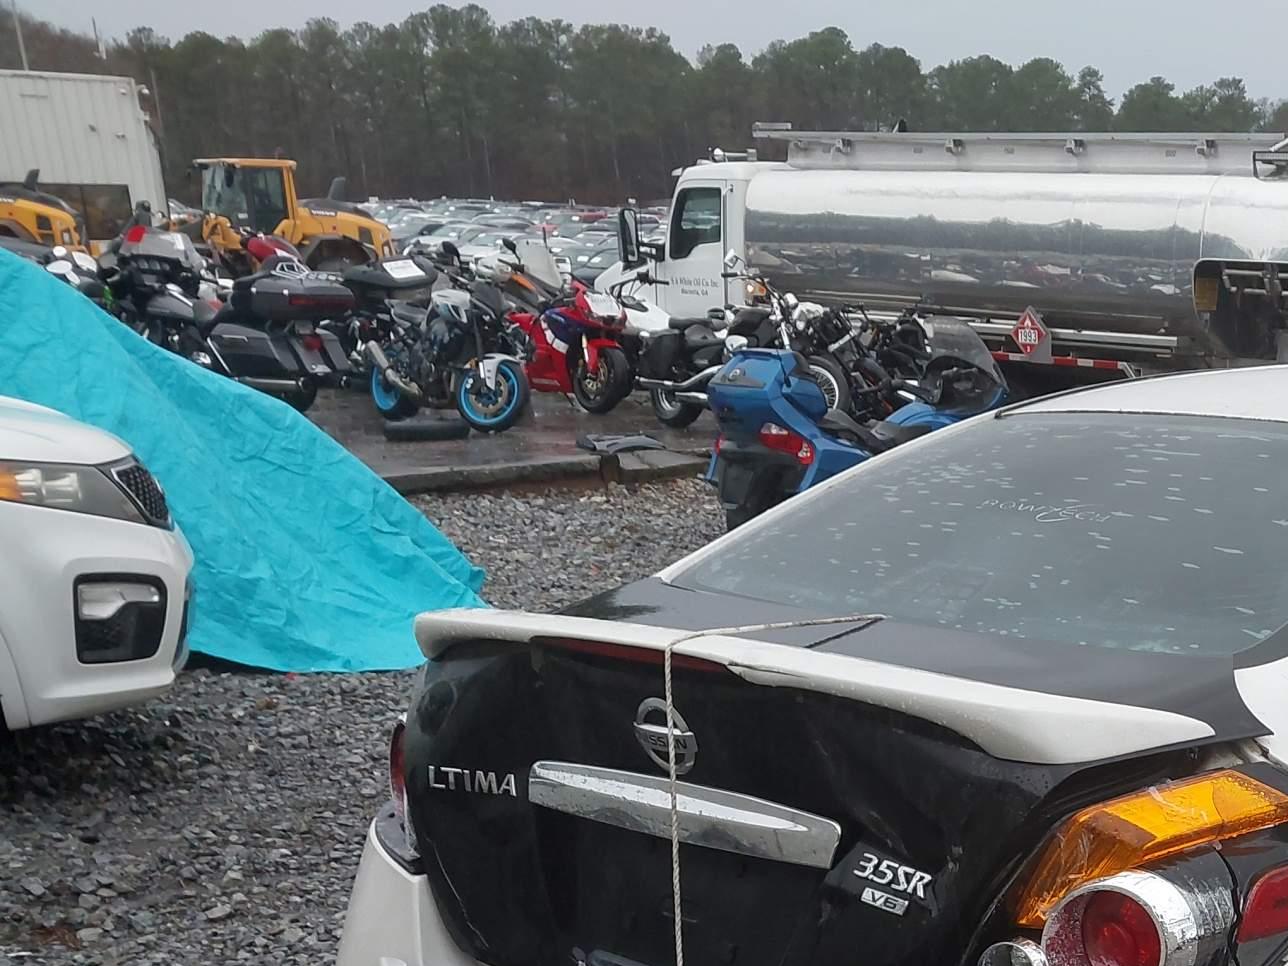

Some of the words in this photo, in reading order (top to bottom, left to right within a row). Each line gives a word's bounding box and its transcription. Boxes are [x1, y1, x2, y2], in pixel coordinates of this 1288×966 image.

[1019, 329, 1038, 343] 1993
[642, 733, 688, 750] SSN
[427, 764, 517, 797] LTIMA
[871, 891, 900, 910] V6
